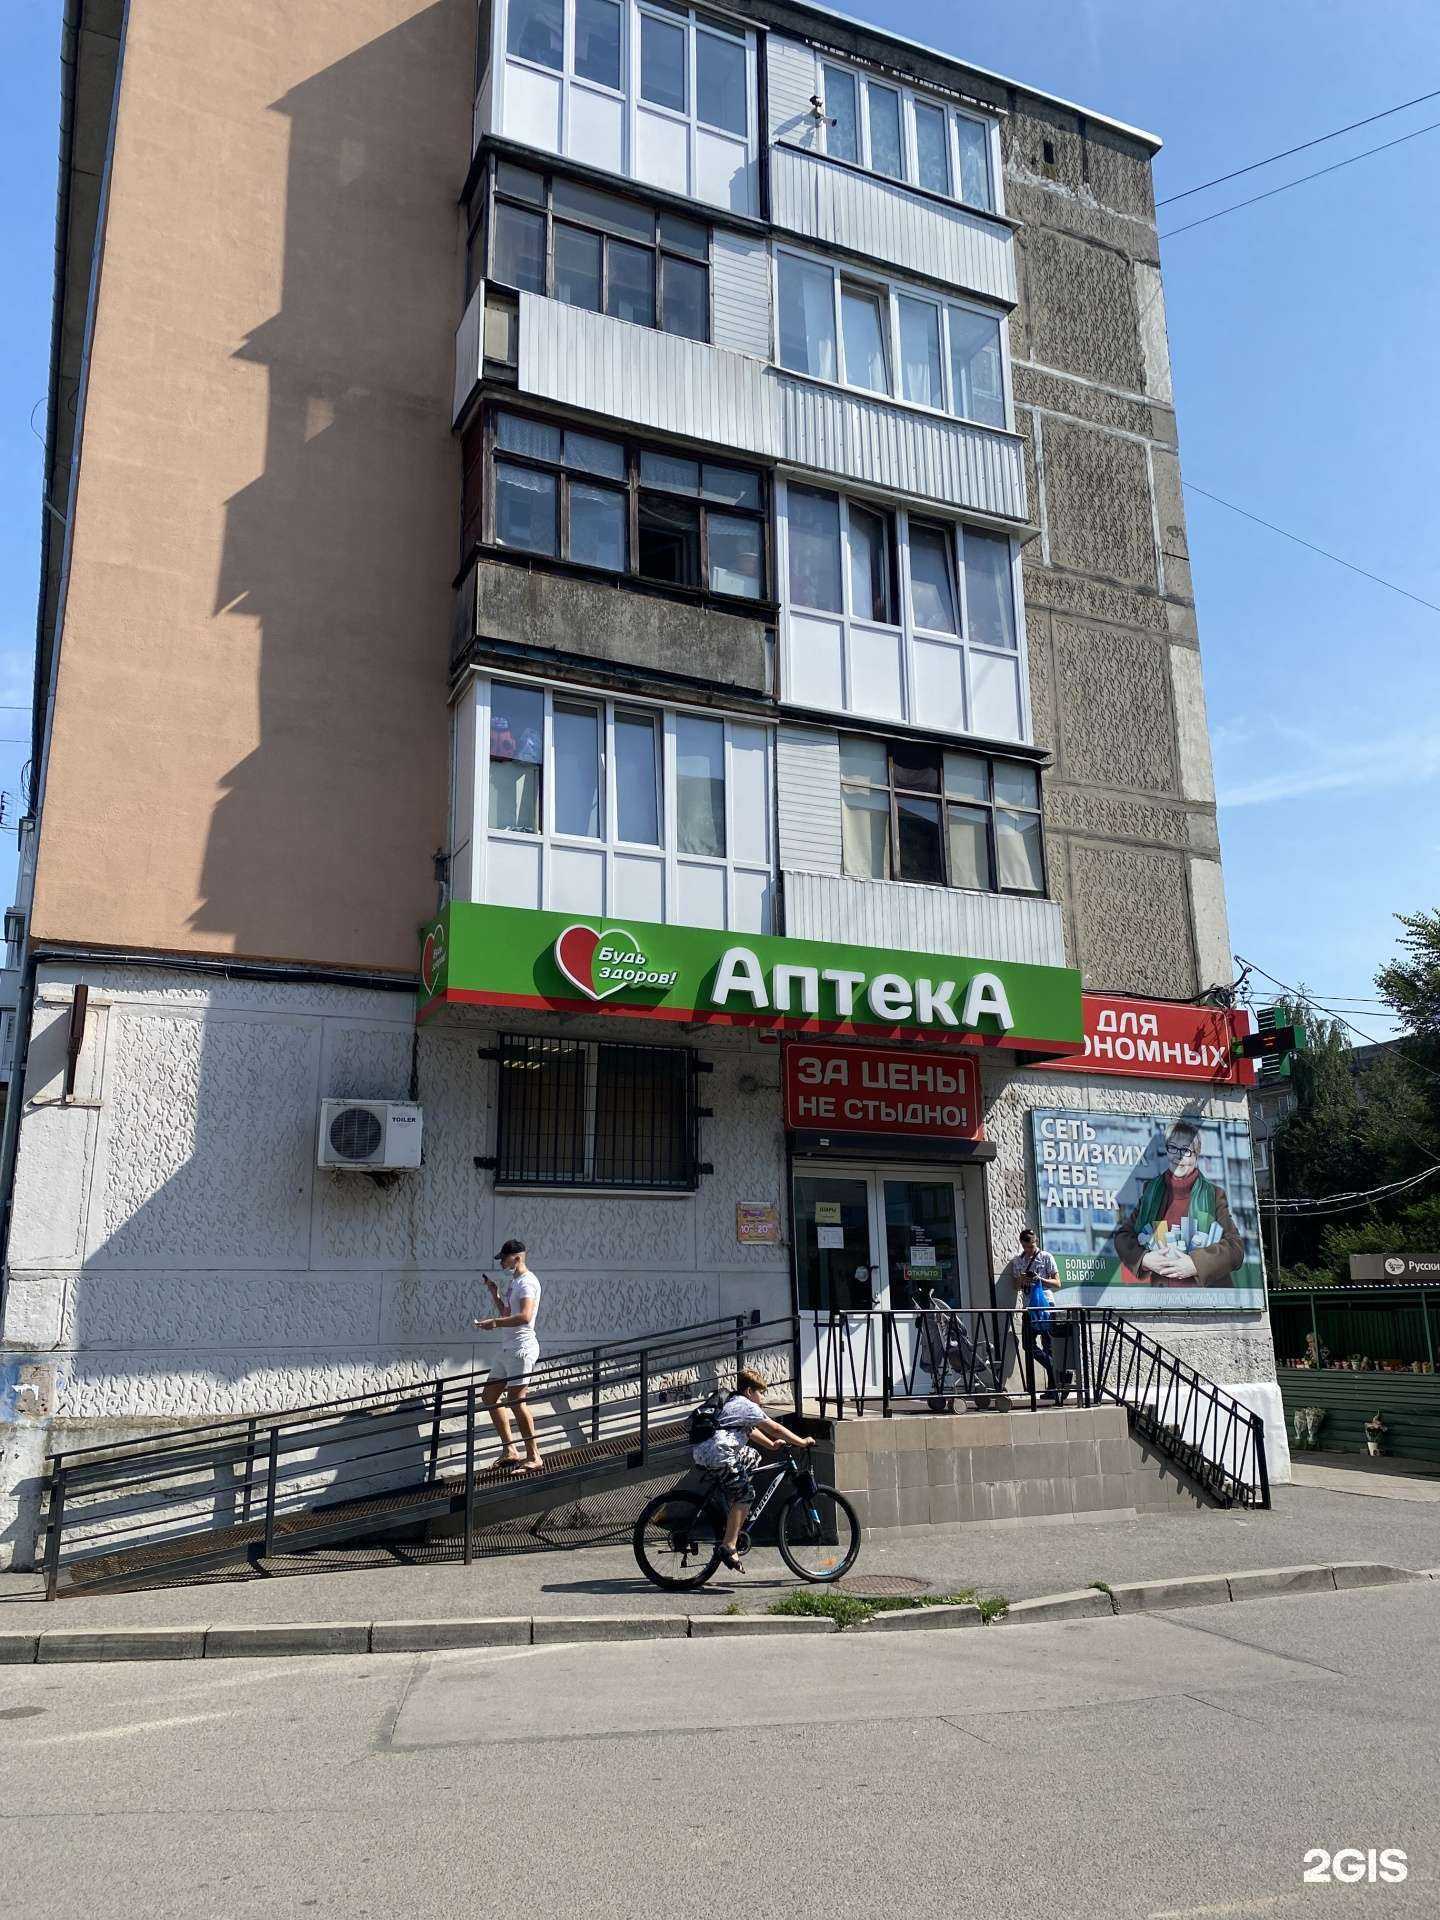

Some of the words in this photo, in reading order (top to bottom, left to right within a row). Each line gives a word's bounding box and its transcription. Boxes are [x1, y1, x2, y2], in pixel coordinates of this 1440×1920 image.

[599, 946, 646, 965] Будь
[599, 966, 678, 985] здоров!
[1096, 1009, 1159, 1036] ДЛЯ
[798, 1057, 848, 1086] ЗА
[861, 1061, 966, 1094] ЦЕНЫ
[799, 1095, 836, 1118] НЕ
[844, 1098, 967, 1127] СТЫДНО!
[1040, 1118, 1096, 1141] СЕТЬ
[1042, 1140, 1149, 1166] БЛИЗКИХ
[1043, 1163, 1100, 1187] ТЕБЕ
[1046, 1186, 1120, 1211] АПТЕК
[1065, 1257, 1107, 1270] БОЛЬШОЙ
[1066, 1270, 1096, 1281] ВЫБОР
